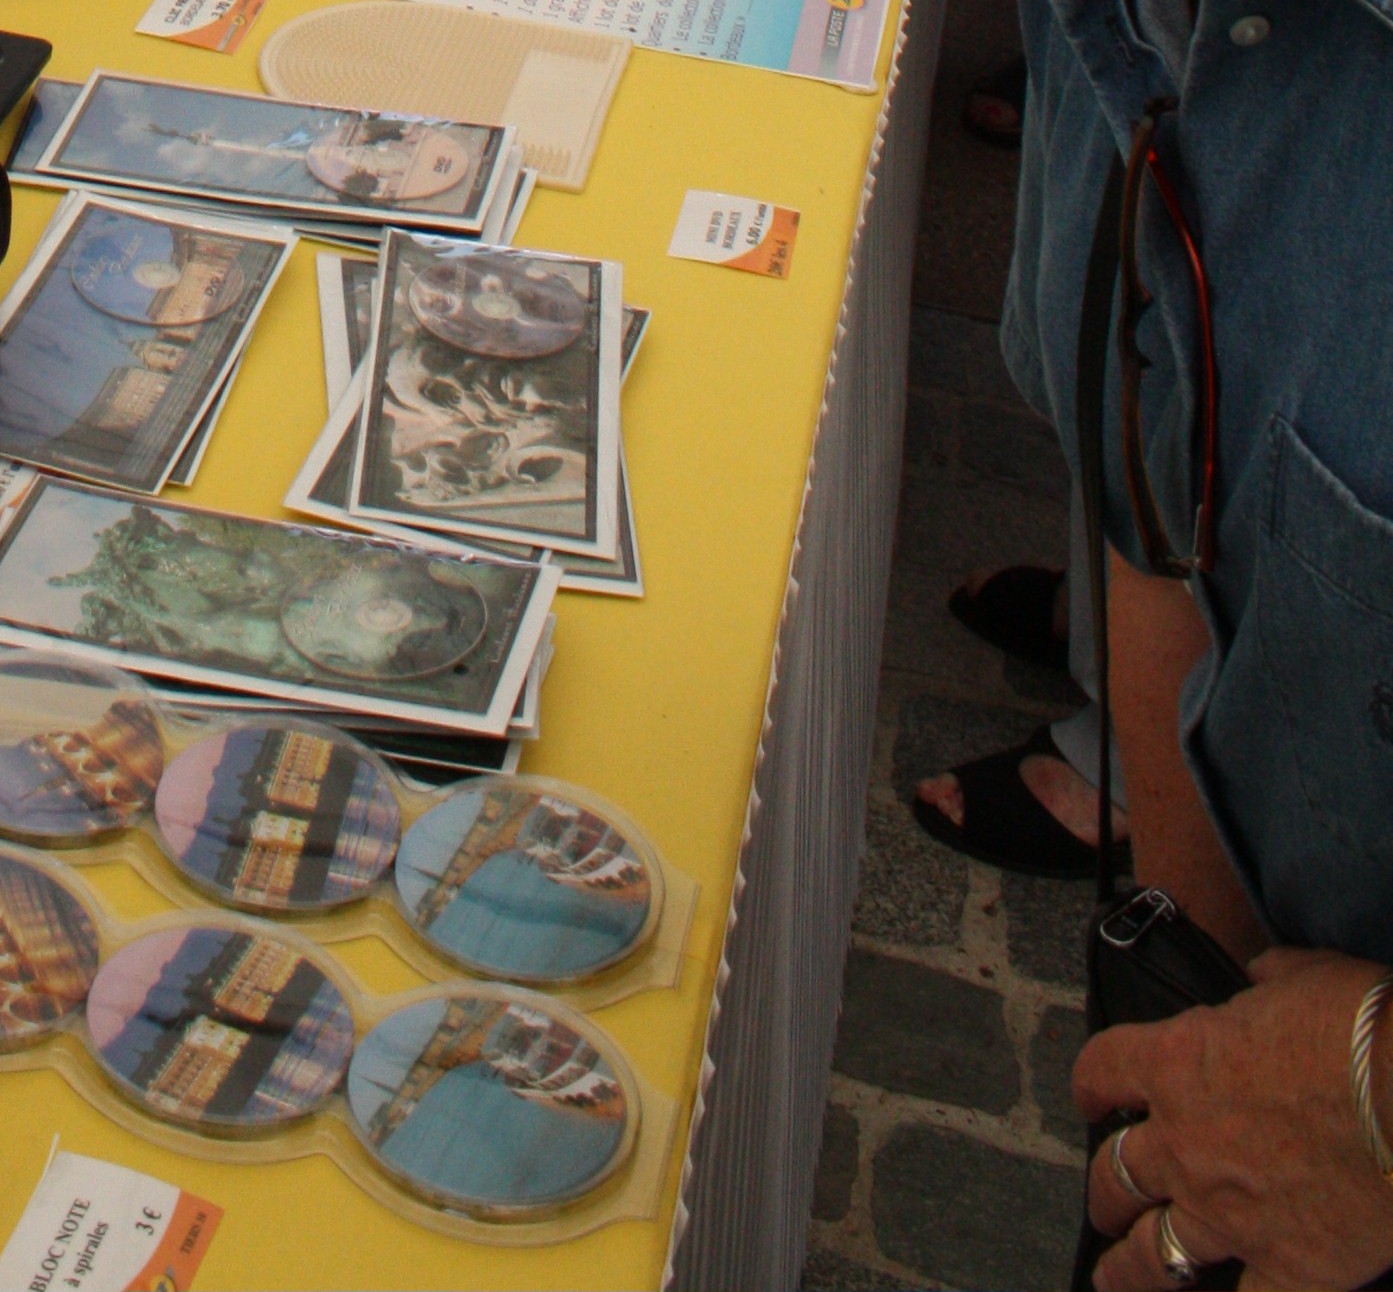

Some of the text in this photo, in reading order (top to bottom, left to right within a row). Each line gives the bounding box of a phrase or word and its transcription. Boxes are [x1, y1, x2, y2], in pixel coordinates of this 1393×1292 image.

[627, 0, 645, 13] de
[671, 30, 689, 41] Le
[697, 34, 715, 45] La
[719, 21, 745, 61] Bordeaux
[826, 10, 845, 46] LA POSTE
[135, 1206, 162, 1237] 3 €
[29, 1198, 91, 1292] BLOC NOTE
[63, 1220, 109, 1289] à spirales
